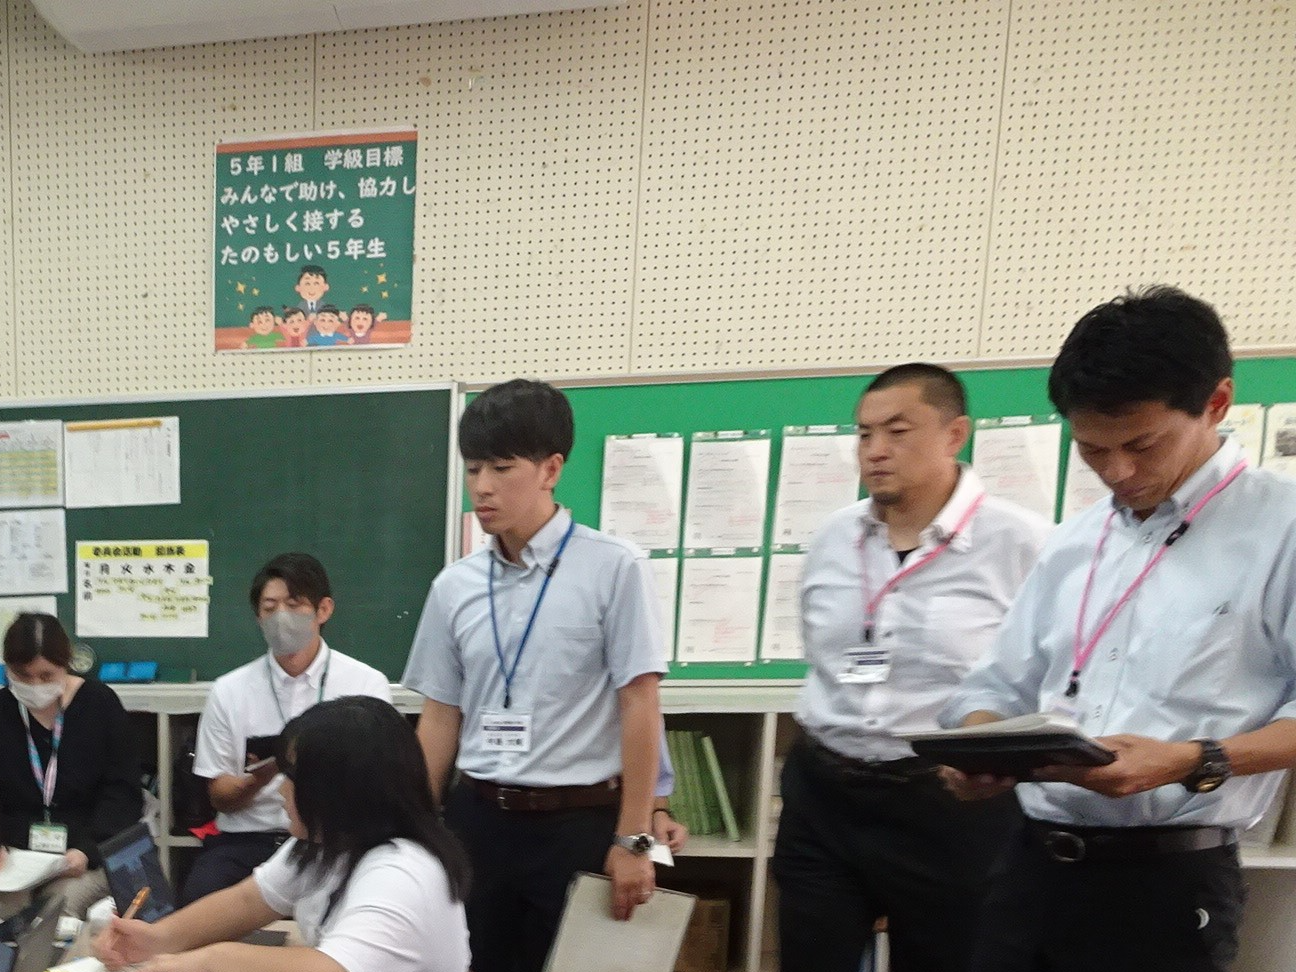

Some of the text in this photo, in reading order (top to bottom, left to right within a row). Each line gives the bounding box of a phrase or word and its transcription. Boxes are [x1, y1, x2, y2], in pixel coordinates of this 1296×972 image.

[230, 145, 404, 176] 5年1組 学級目標
[220, 175, 416, 205] みんなで助け、協力し
[220, 207, 365, 235] やさしく接する
[220, 237, 387, 266] たのもしい5年生
[120, 562, 134, 576] 火
